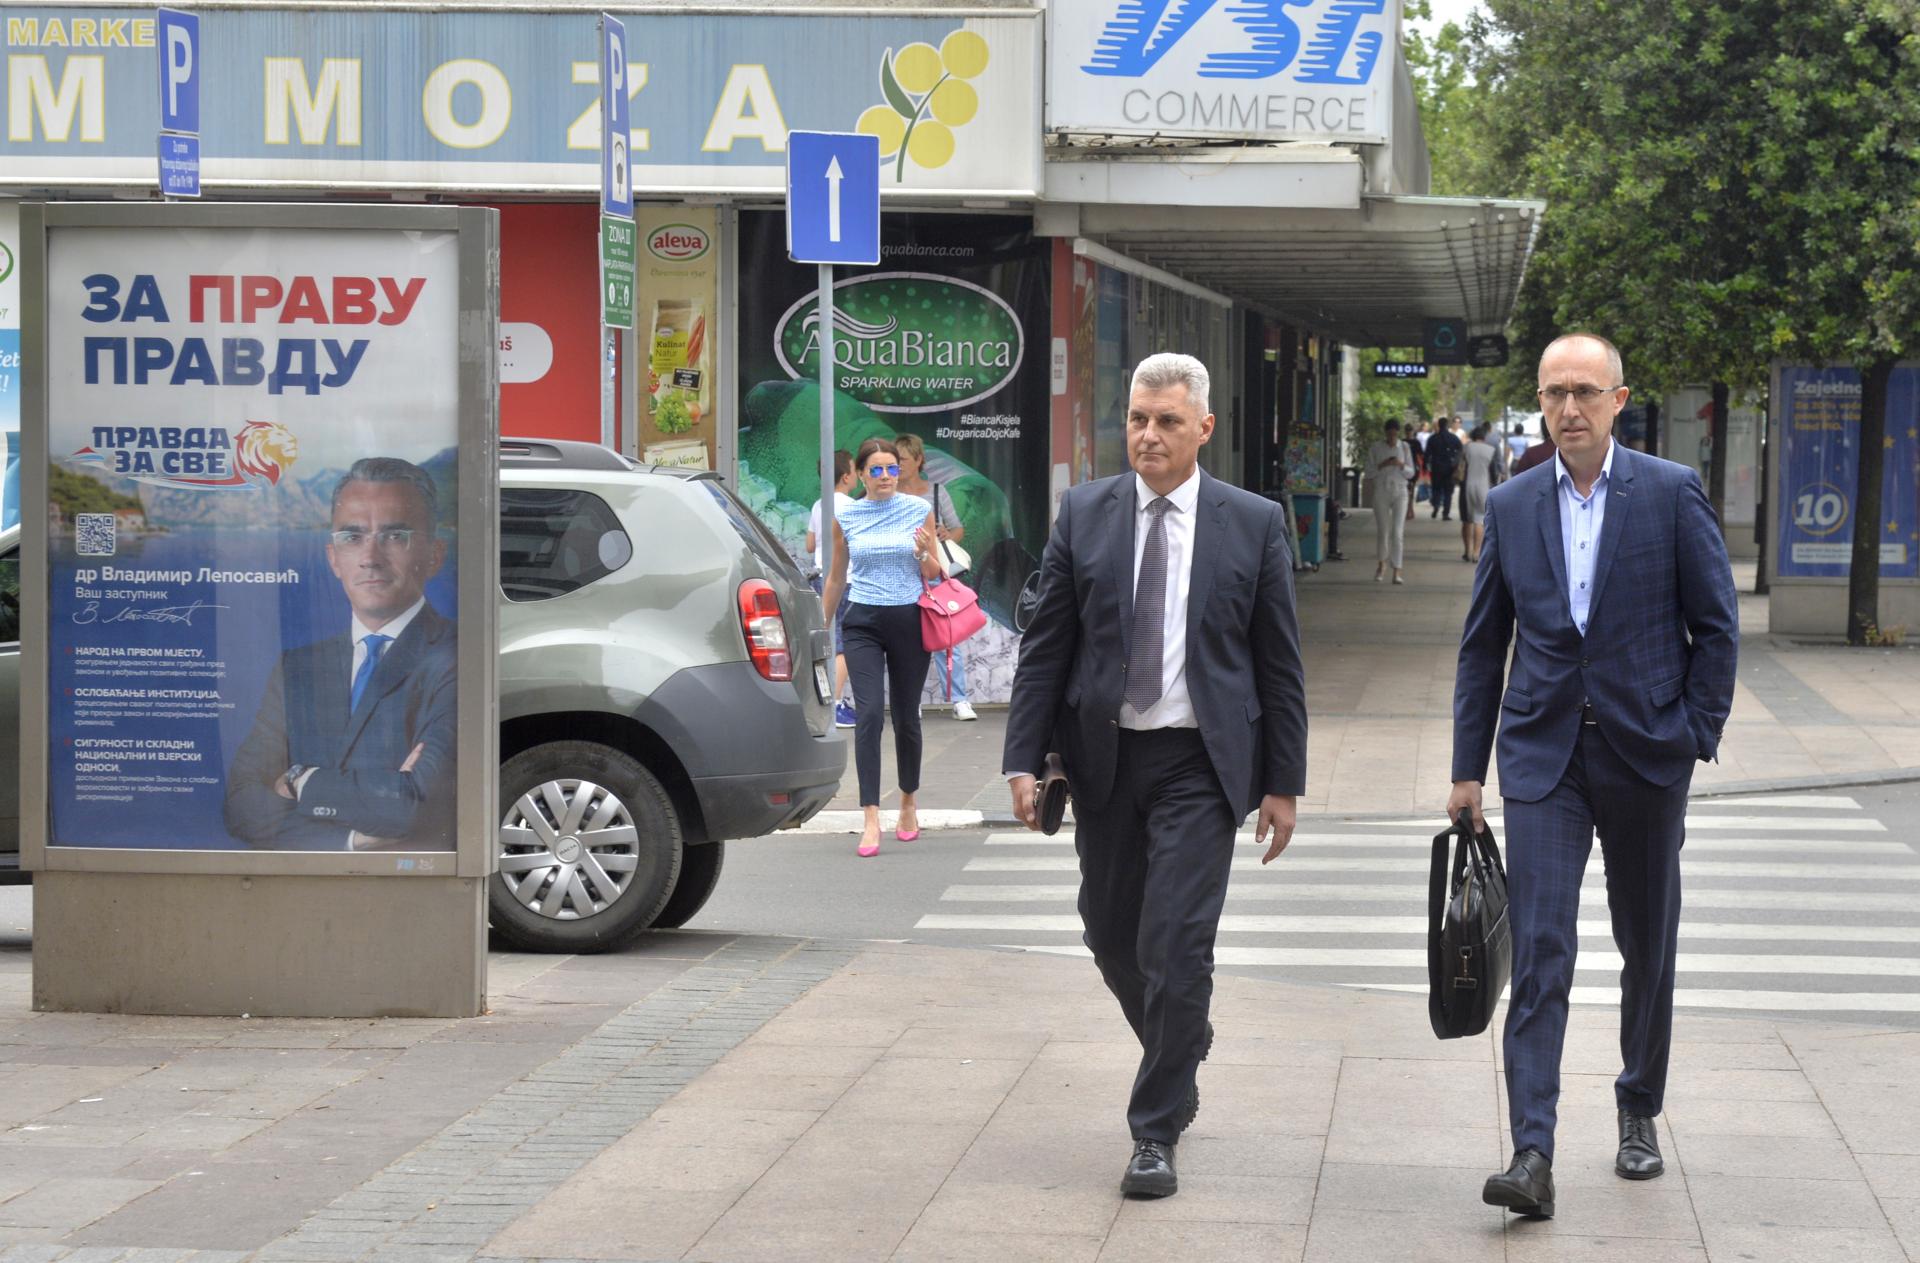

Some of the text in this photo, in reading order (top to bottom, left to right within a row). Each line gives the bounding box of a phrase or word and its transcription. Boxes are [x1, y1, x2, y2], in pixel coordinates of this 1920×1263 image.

[7, 17, 156, 47] MARKE
[167, 24, 192, 117] P
[610, 32, 623, 121] P
[1122, 88, 1368, 131] COMMERCE
[608, 226, 625, 244] ZONA
[654, 232, 702, 249] aleva
[881, 243, 975, 259] quabianca.com
[81, 273, 427, 326] ЗА ПРАВУ
[798, 329, 1011, 373] AquaBianca
[84, 336, 371, 395] ПРАВДУ
[1376, 364, 1426, 374] BARBOSA
[840, 376, 973, 389] SPARKLING WATER
[961, 414, 1021, 428] #BiancaKisjela
[92, 427, 231, 449] ПРАВДА
[115, 451, 226, 474] ЗА СВЕ
[1795, 493, 1842, 527] 10
[75, 567, 299, 586] др Владимир Лепосавић
[75, 587, 168, 602] Ваш заступник
[75, 647, 110, 658] НАРОД
[111, 648, 126, 657] НА
[127, 648, 163, 657] ПРВОМ
[74, 688, 146, 699] ОСЛОБАЂАЊЕ
[74, 739, 195, 750] СИГУРНОСТ И СКЛАДНИ
[75, 751, 202, 761] НАЦИОНАЛНИ И ВЈЕРСКИ
